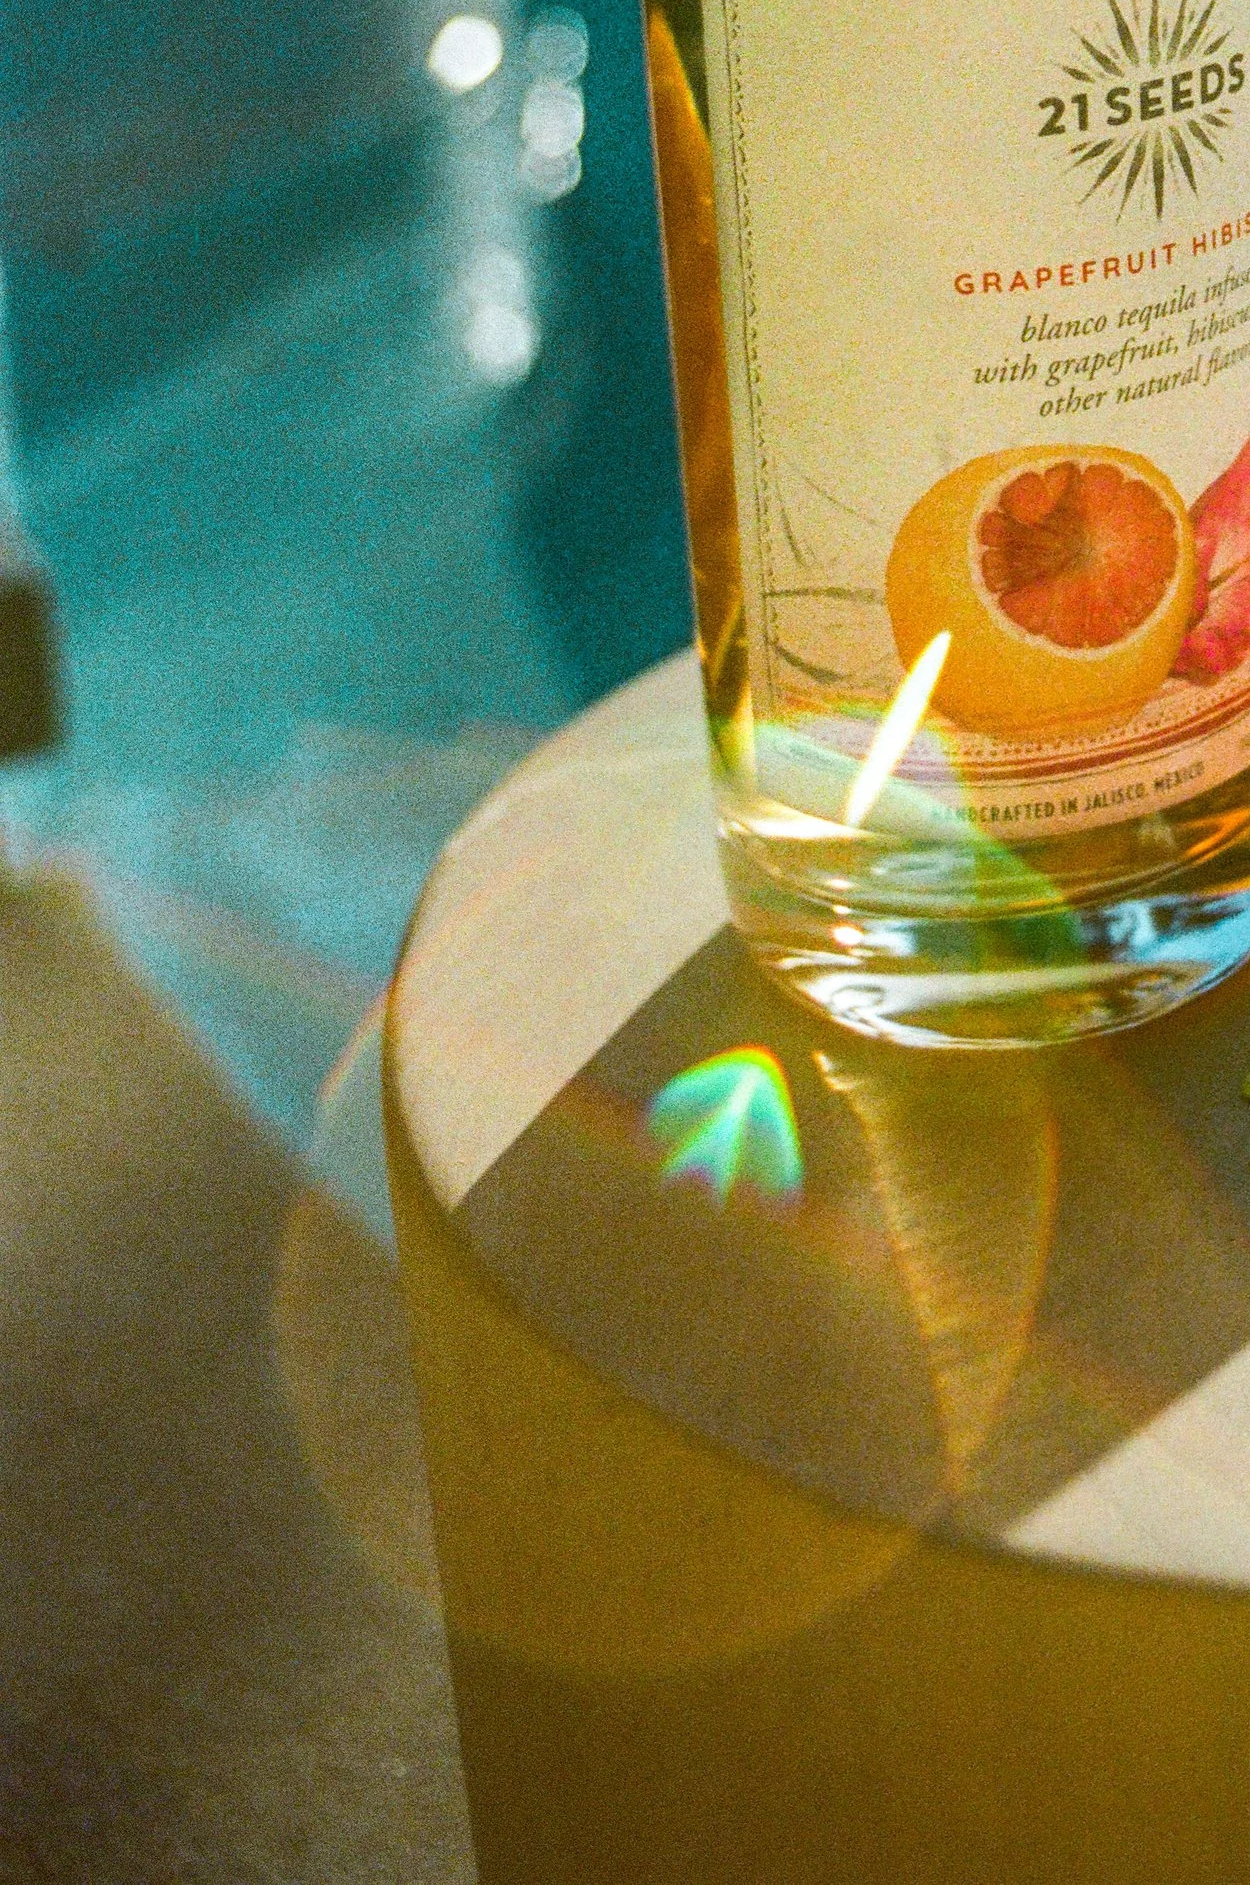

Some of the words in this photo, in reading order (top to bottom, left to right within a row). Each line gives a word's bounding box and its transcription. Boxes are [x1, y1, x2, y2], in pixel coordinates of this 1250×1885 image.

[1038, 94, 1088, 137] 21
[1104, 52, 1245, 126] SEEDS
[953, 242, 1176, 295] GRAPEFRUIT
[1021, 313, 1108, 343] blanco
[1117, 284, 1197, 334] tequila
[973, 353, 1037, 384] with
[1044, 333, 1179, 393] grapefruit,
[1039, 387, 1108, 416] other
[1115, 354, 1202, 404] natural
[931, 801, 1056, 823] NDCRAFTED
[1060, 797, 1079, 817] IN
